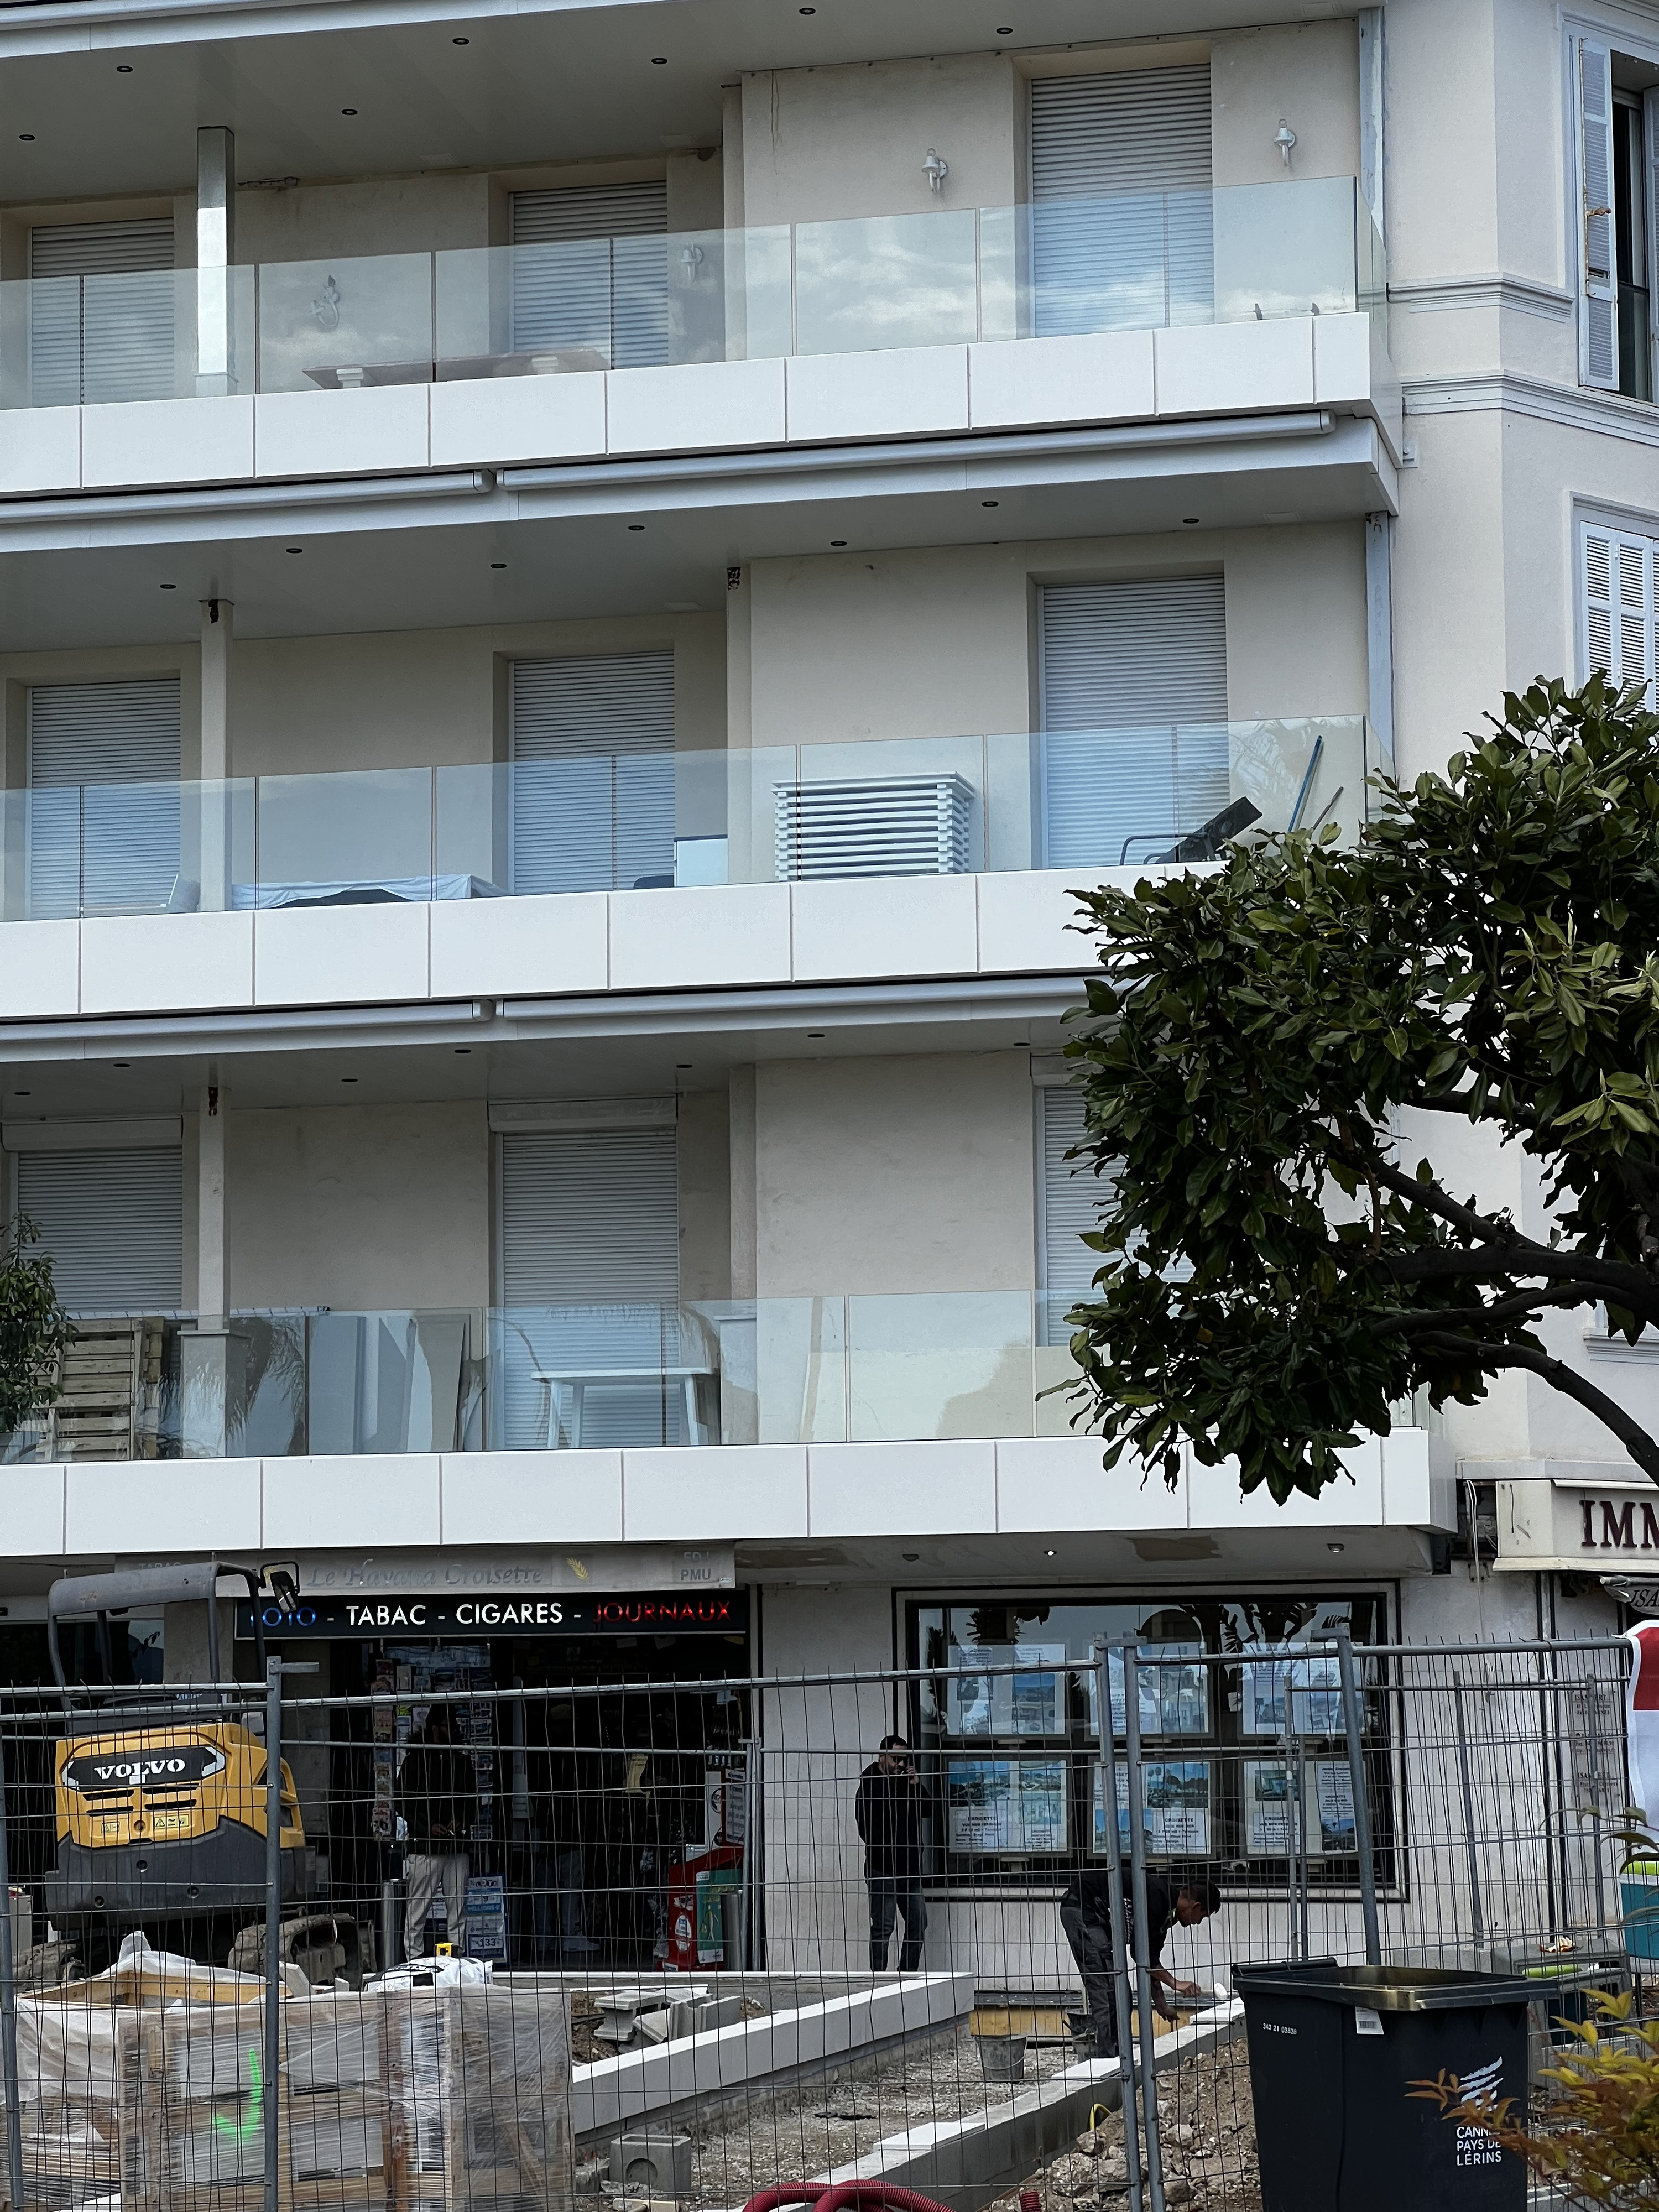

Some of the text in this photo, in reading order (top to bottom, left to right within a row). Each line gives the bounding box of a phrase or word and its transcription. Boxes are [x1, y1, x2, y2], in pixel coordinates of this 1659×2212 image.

[307, 1558, 543, 1588] Le Havana Croisette
[681, 1568, 711, 1581] PMU
[346, 1604, 426, 1626] TABAC
[456, 1603, 563, 1624] CIGARES
[593, 1600, 731, 1623] JOURNAUX
[93, 1758, 186, 1780] VOLVO
[1456, 2126, 1501, 2138] CANN
[1457, 2139, 1484, 2152] PAYS
[1457, 2150, 1502, 2166] LÉRINS
